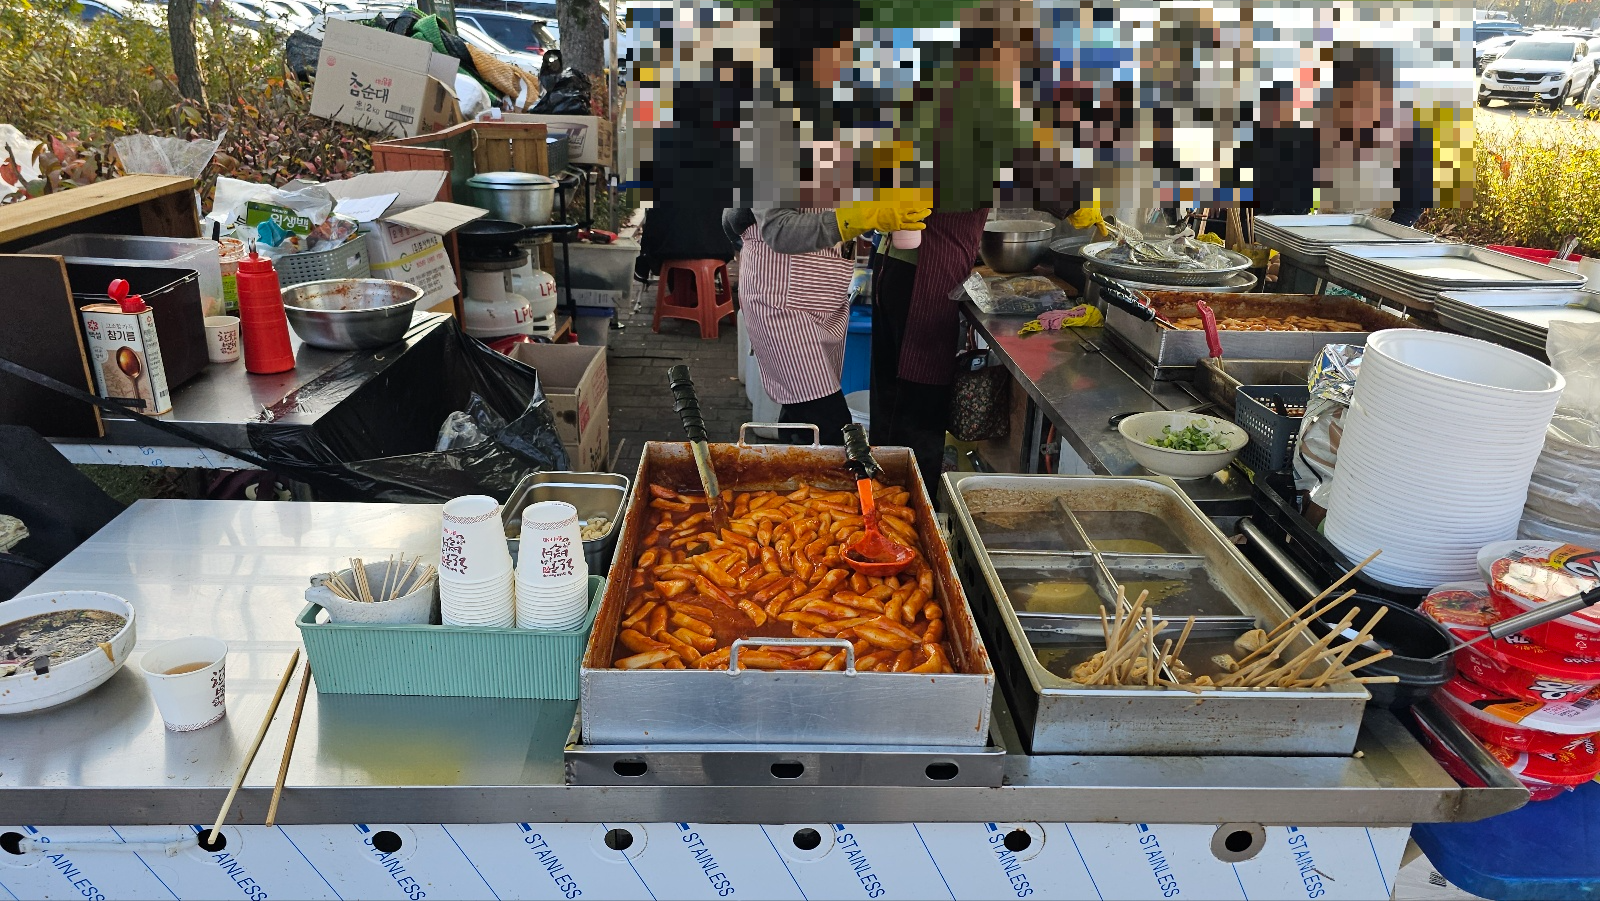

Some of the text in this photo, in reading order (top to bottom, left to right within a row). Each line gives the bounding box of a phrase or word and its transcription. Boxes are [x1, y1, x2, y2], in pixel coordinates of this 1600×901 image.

[349, 71, 390, 104] 참순대
[271, 213, 309, 231] 위생백
[107, 330, 136, 342] 참기름
[525, 833, 583, 900] STAINLESS
[682, 832, 735, 898] STAINLESS
[836, 833, 886, 899] STAINLESS
[1139, 834, 1180, 899] STAINLESS
[1288, 834, 1325, 900] STAINLESS
